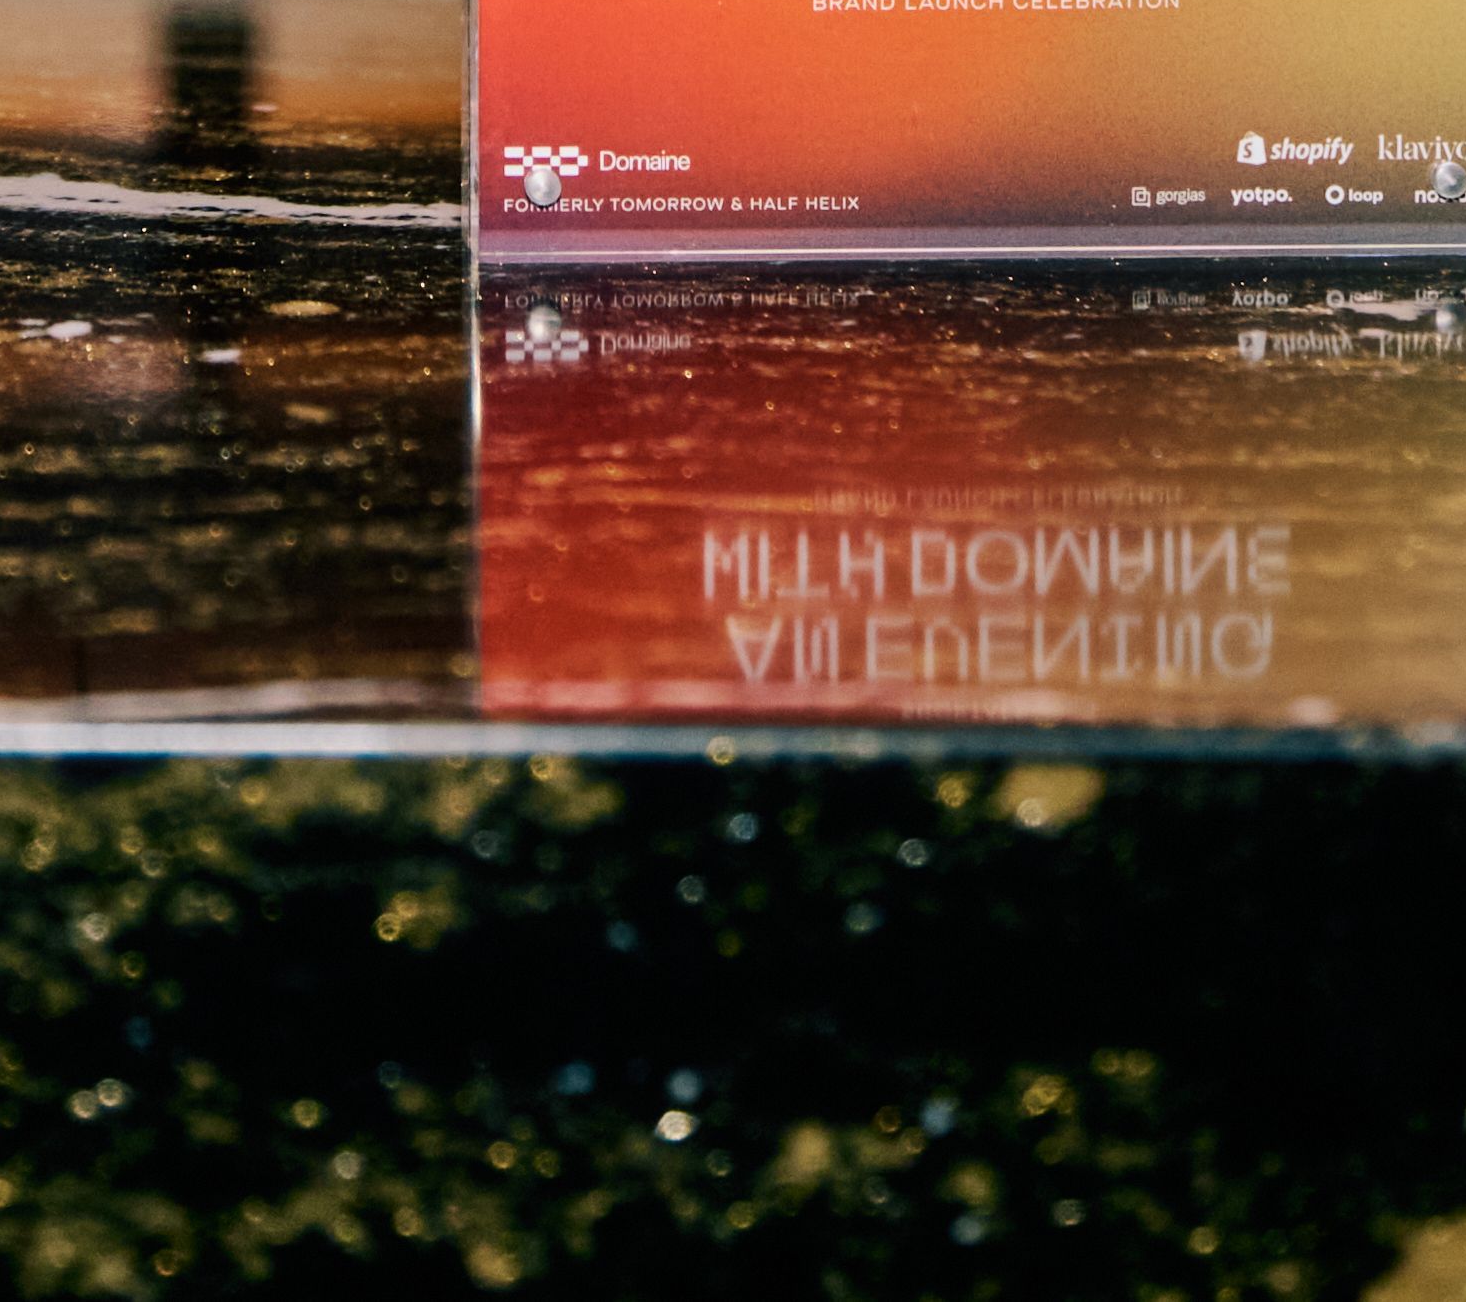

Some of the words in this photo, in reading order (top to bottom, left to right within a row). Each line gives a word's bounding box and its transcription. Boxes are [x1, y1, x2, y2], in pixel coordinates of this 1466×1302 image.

[1270, 137, 1354, 165] shopify
[599, 149, 691, 172] Domaine
[610, 197, 724, 212] TOMORROW
[731, 198, 744, 211] &
[750, 197, 799, 211] HALF
[805, 197, 860, 210] HELIX
[1155, 188, 1206, 206] gorgias
[1231, 188, 1293, 206] yotpo.
[1348, 188, 1384, 205] loop
